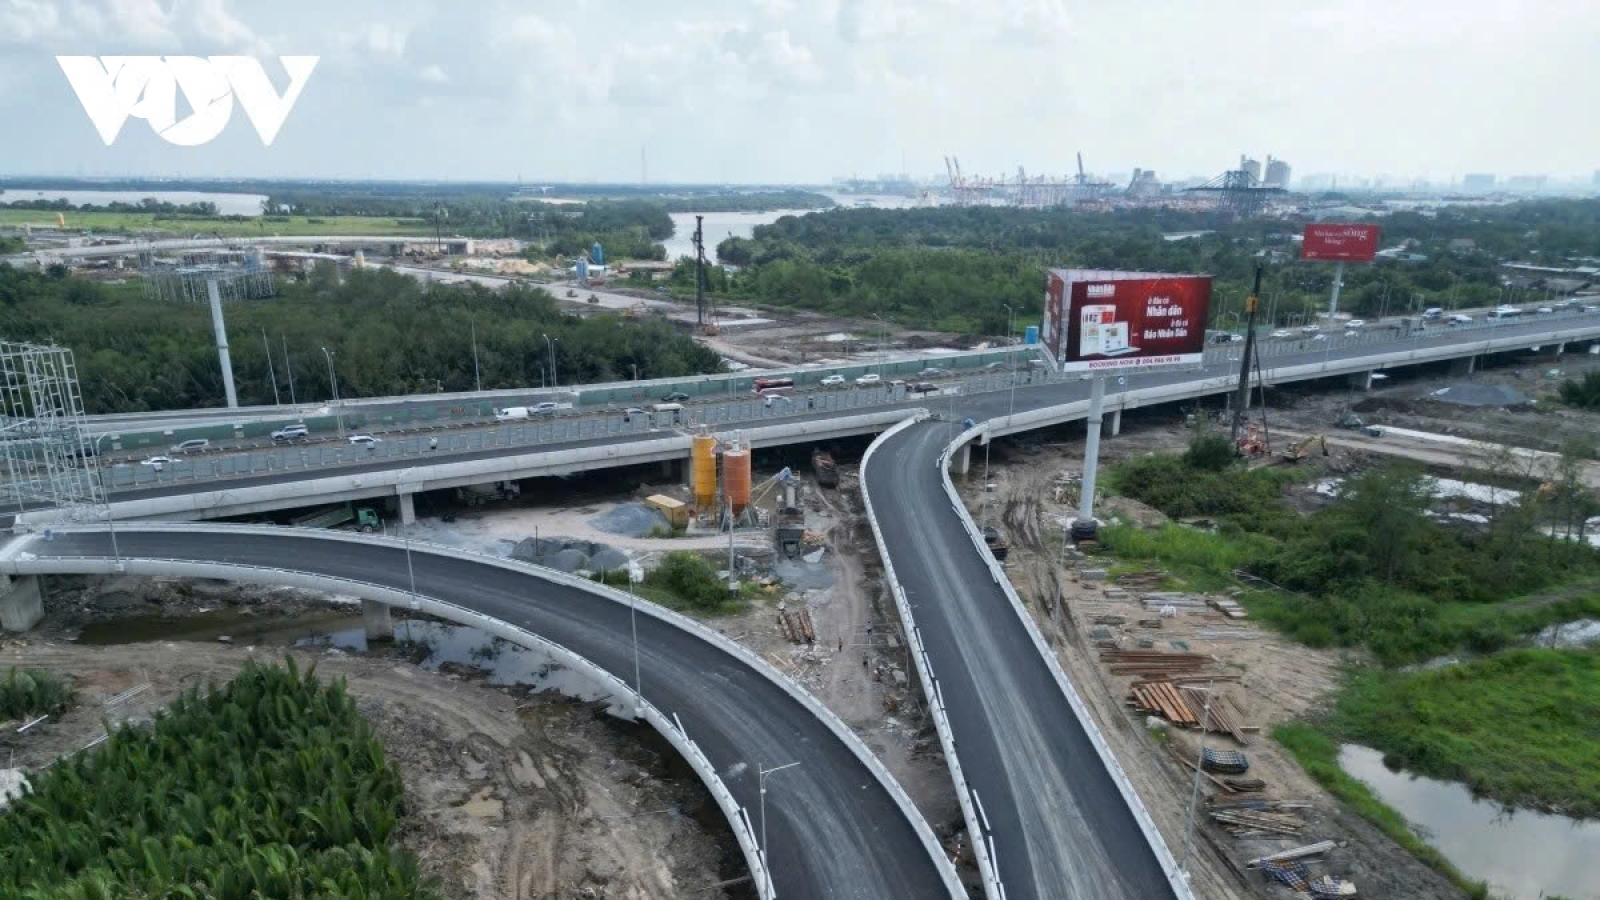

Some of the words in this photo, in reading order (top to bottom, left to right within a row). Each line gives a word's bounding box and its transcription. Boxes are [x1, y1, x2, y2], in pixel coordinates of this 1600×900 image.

[1147, 305, 1167, 316] Nhân
[1168, 305, 1182, 316] dân
[1144, 329, 1156, 339] Báo
[1158, 328, 1174, 338] Nhân
[1175, 328, 1187, 337] Dân
